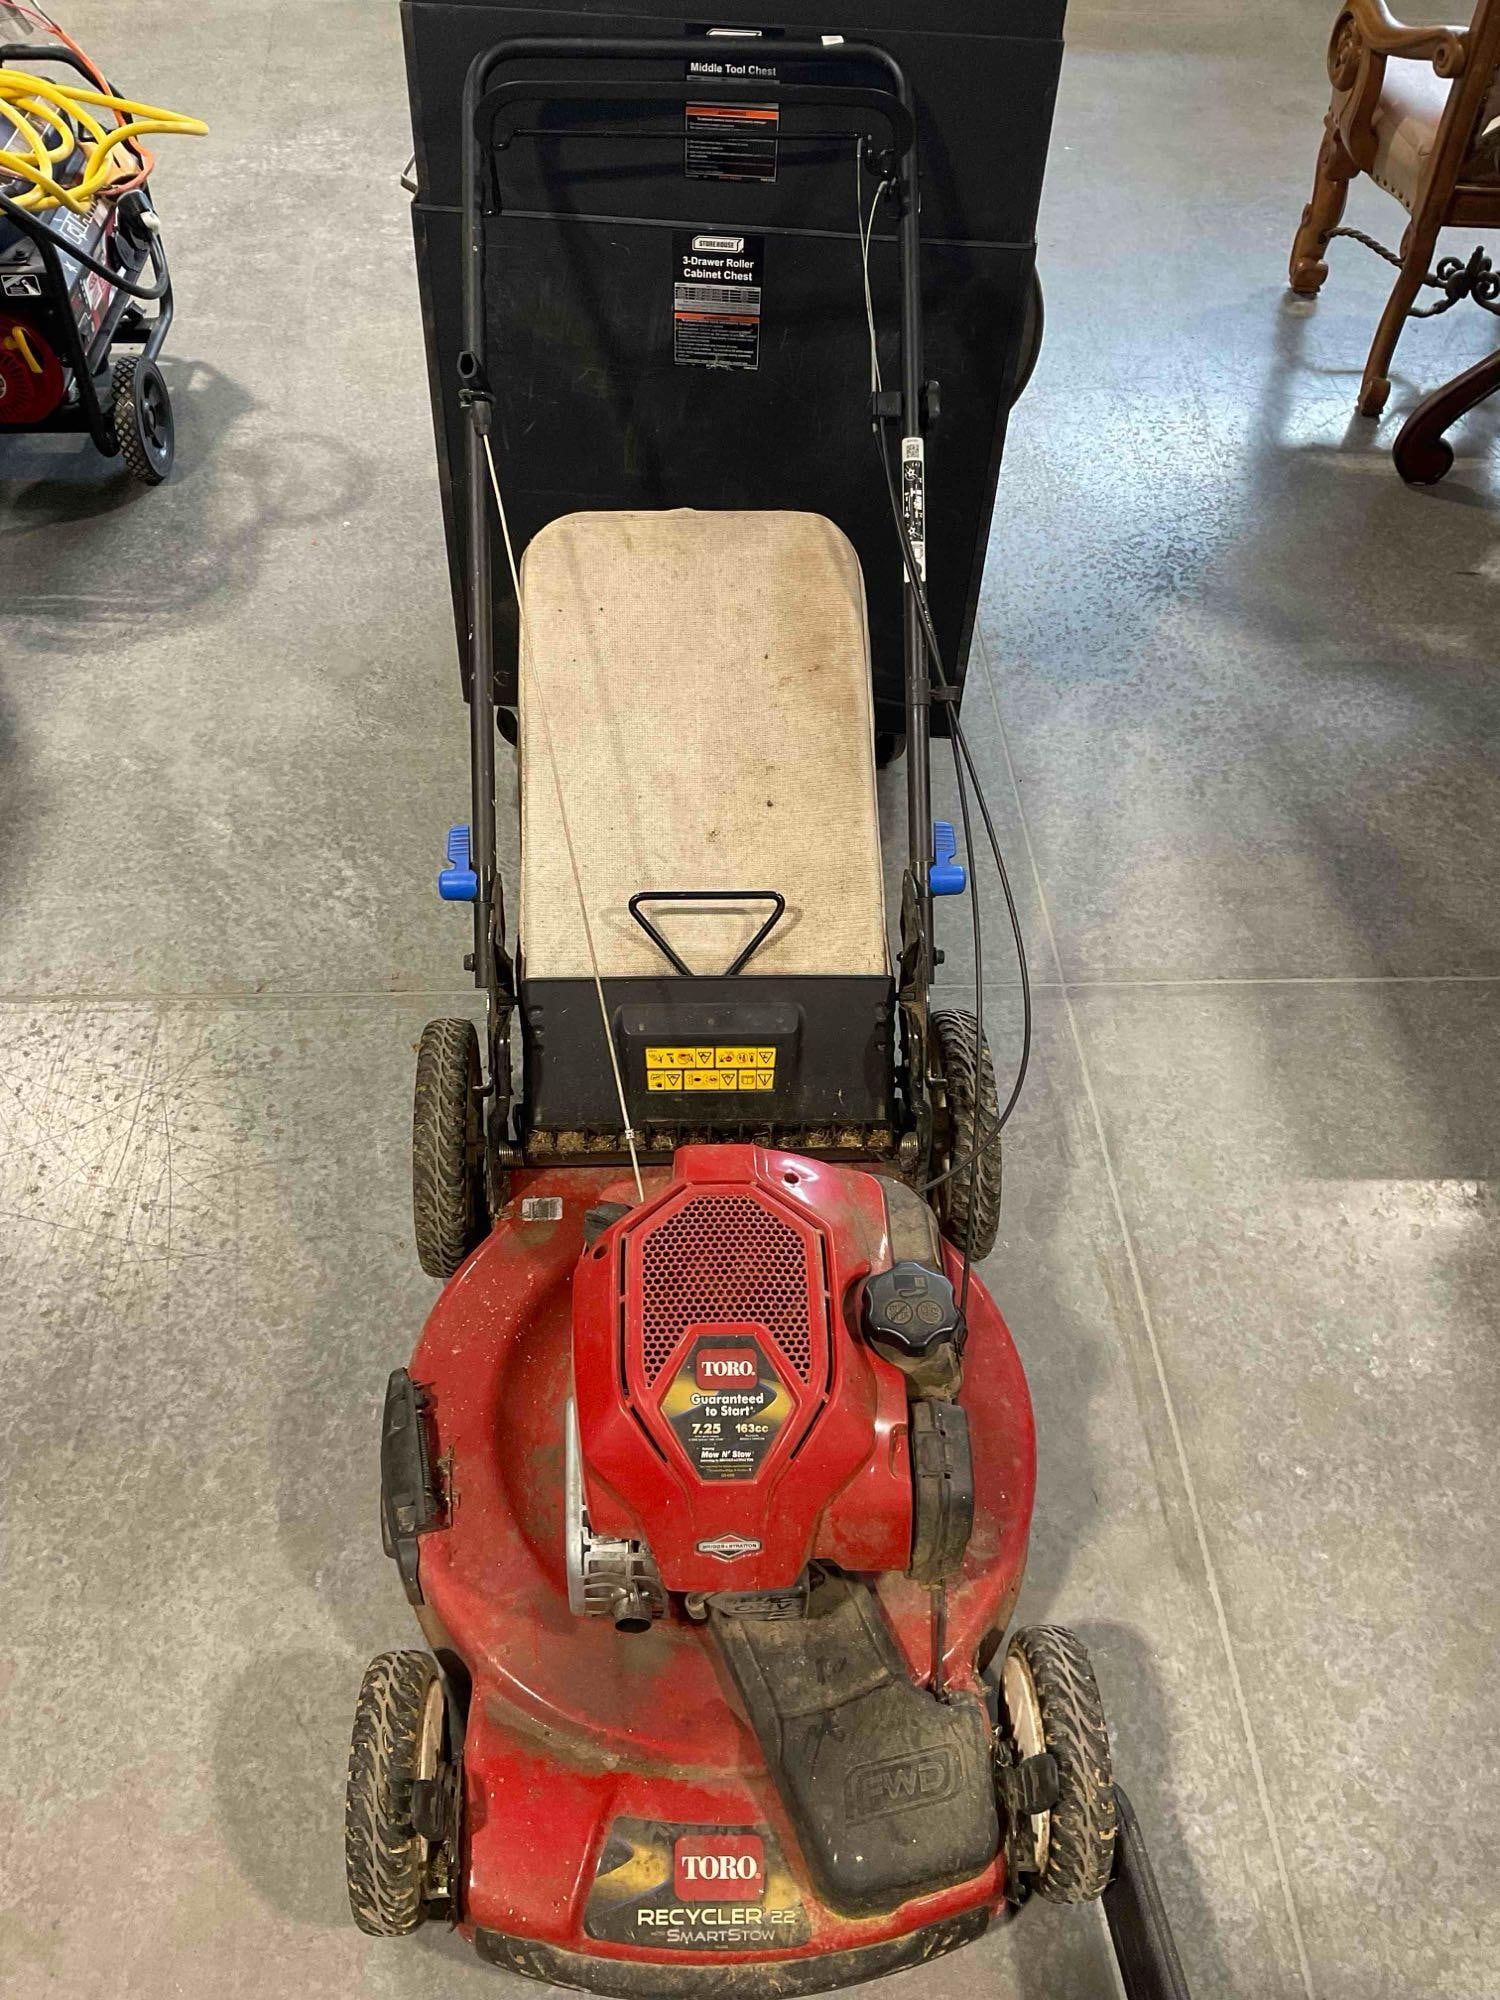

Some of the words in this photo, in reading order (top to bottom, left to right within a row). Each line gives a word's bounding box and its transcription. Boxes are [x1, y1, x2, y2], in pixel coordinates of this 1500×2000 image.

[690, 62, 723, 73] Middle
[725, 63, 746, 74] Tool
[748, 65, 777, 76] Chest
[698, 240, 735, 249] STOREHOUSE
[682, 255, 725, 268] 3-Drawer
[726, 258, 755, 269] Roller
[683, 268, 722, 279] Cabinet
[723, 270, 753, 281] Chest
[702, 1360, 754, 1377] TORO
[691, 1392, 764, 1405] Guaranteed
[705, 1406, 718, 1417] to
[691, 1423, 722, 1435] 7.25
[735, 1423, 769, 1434] 163cc
[701, 1450, 720, 1459] Mow
[859, 1761, 945, 1806] FWD
[681, 1855, 758, 1880] TORO
[637, 1908, 763, 1926] RECYCLER
[771, 1910, 796, 1924] 22
